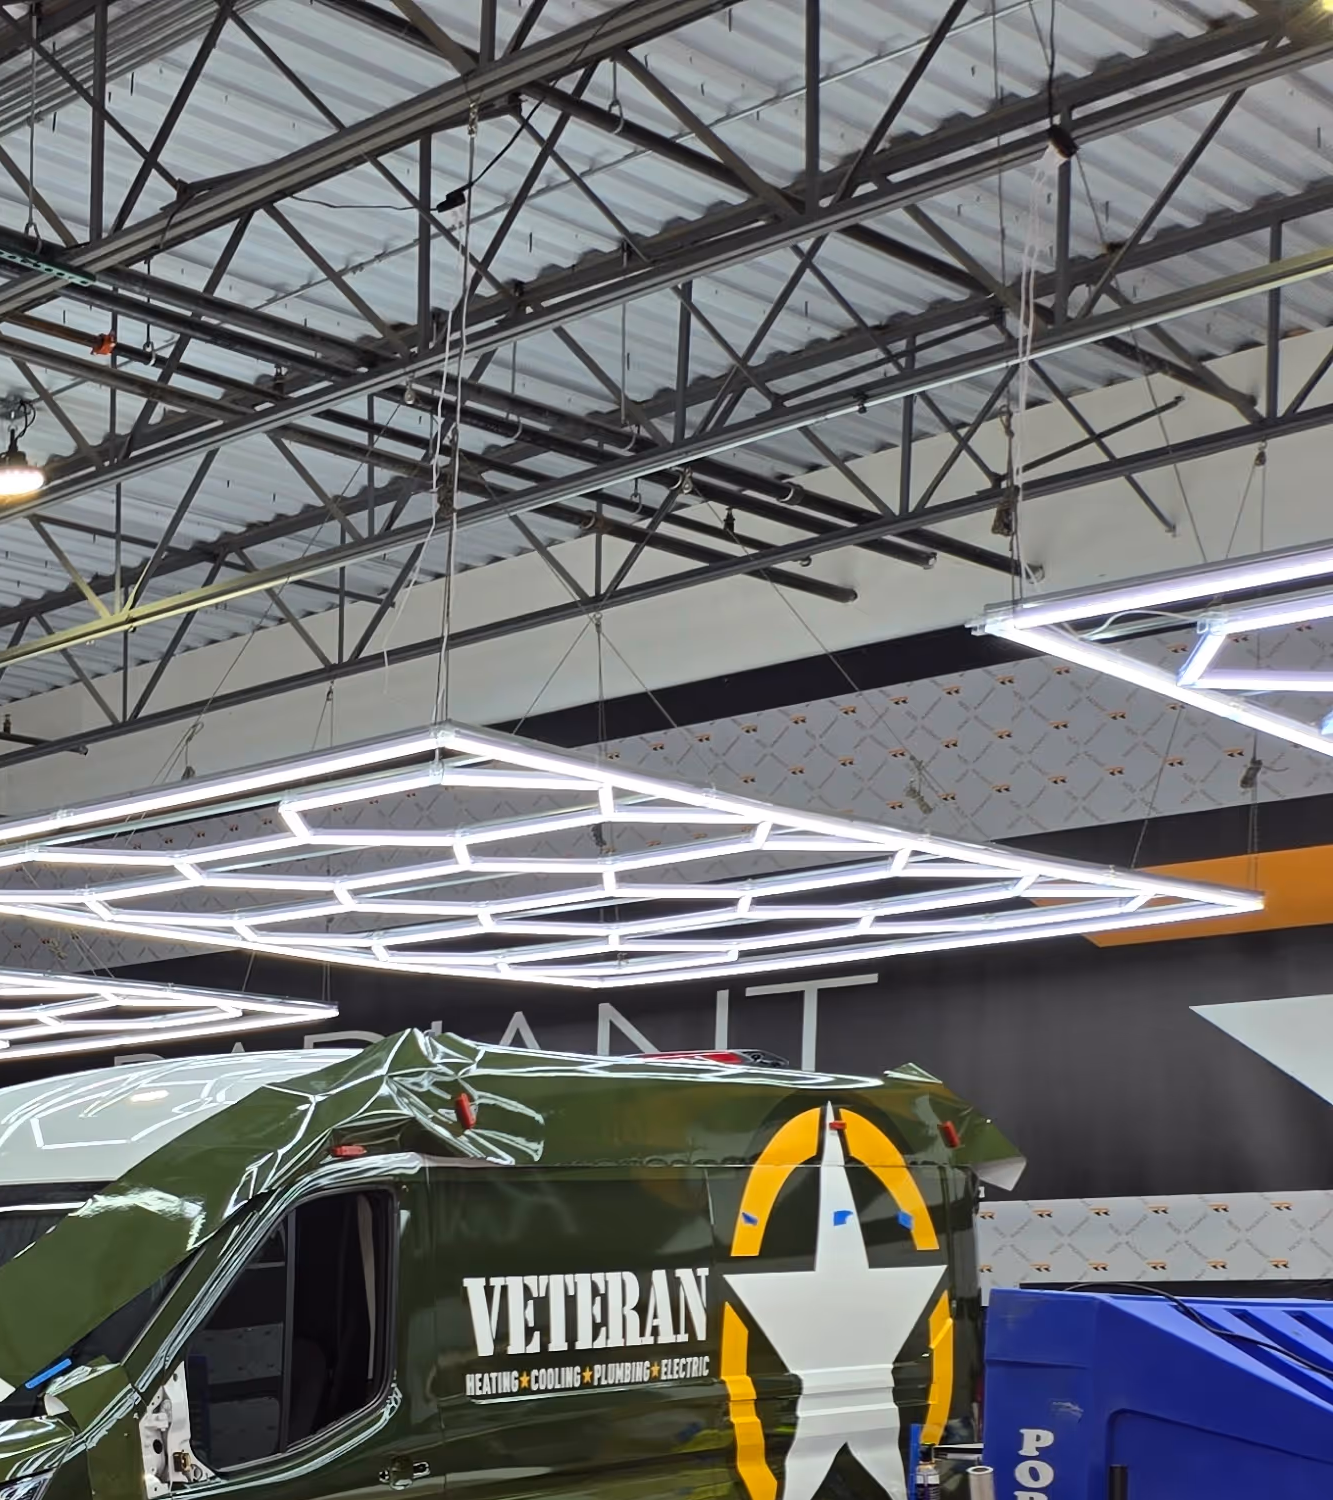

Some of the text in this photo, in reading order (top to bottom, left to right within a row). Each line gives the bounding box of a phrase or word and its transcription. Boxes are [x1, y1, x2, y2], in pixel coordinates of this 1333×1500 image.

[462, 1267, 710, 1357] VETERAN
[466, 1356, 710, 1396] HEATING COOLING PLUMBING ELECTRIC
